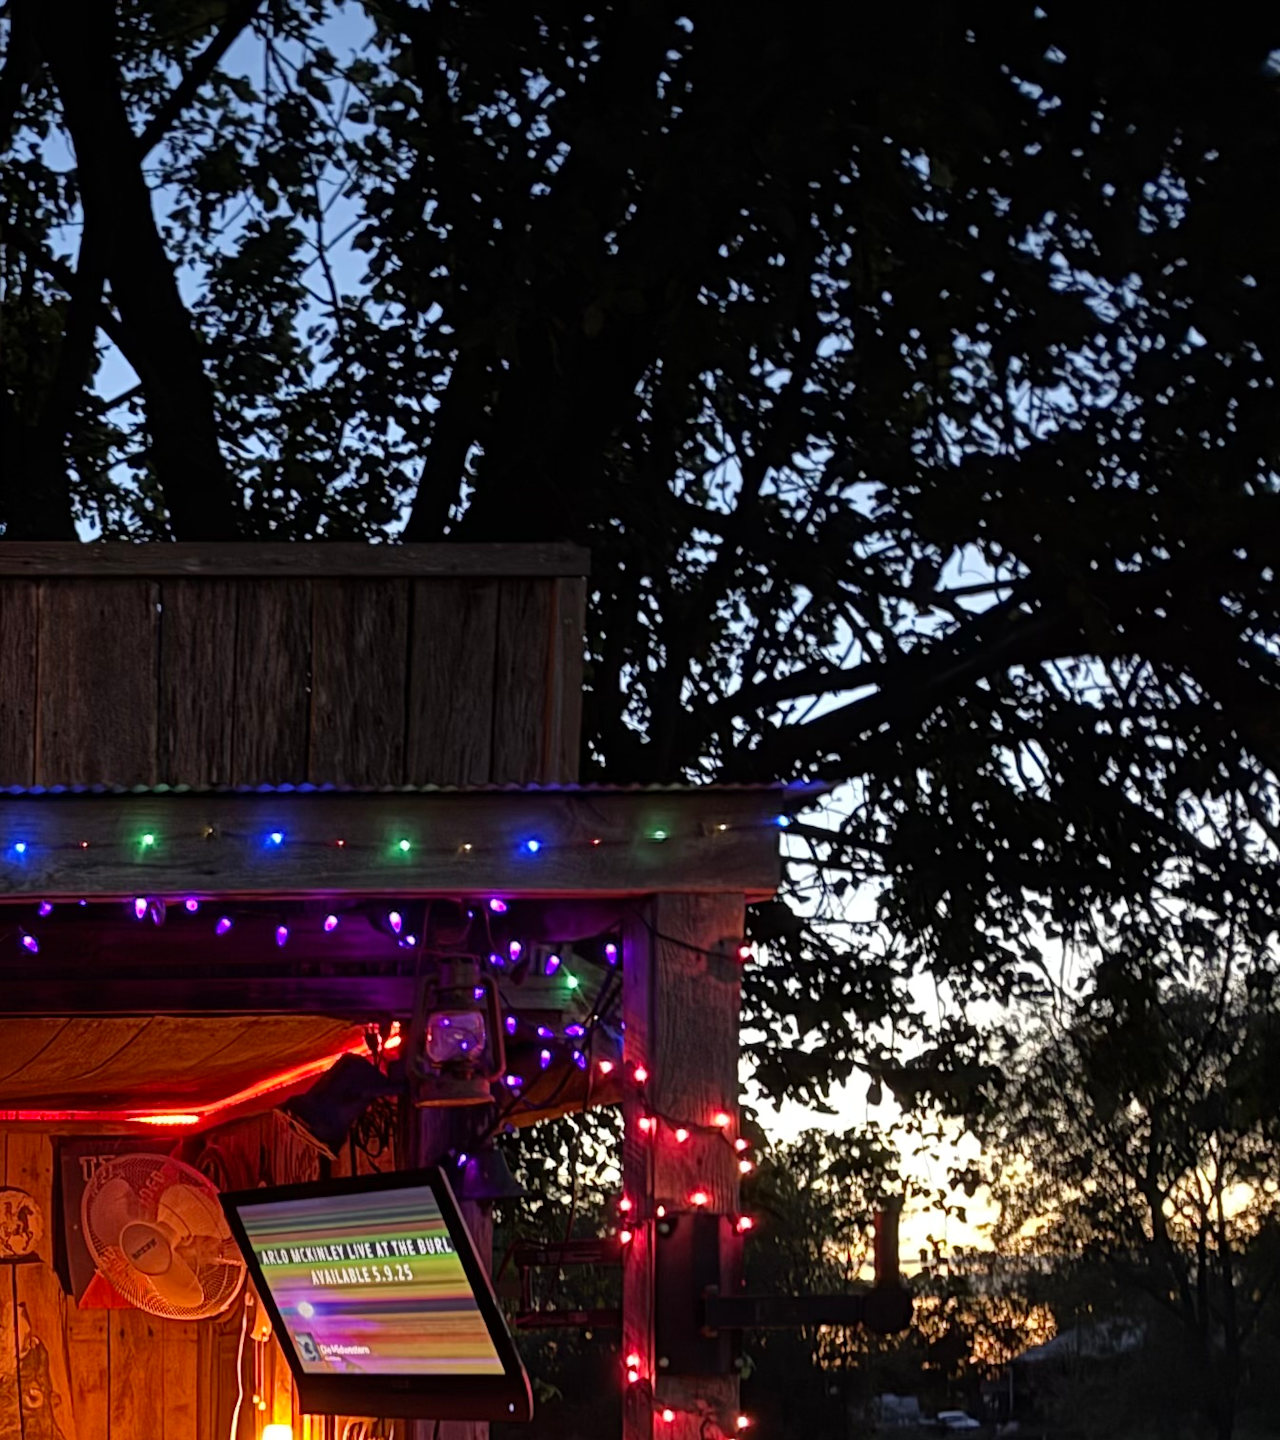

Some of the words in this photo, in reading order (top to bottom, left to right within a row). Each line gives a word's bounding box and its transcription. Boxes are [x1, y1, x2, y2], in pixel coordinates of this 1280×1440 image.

[261, 1248, 289, 1266] ARLO
[289, 1244, 345, 1264] MCKINLEY
[346, 1241, 374, 1260] LIVE
[375, 1240, 390, 1258] AT
[391, 1239, 416, 1257] THE
[416, 1236, 453, 1255] BURL
[310, 1265, 371, 1286] AVAILABLE
[371, 1263, 414, 1283] 5.9.25
